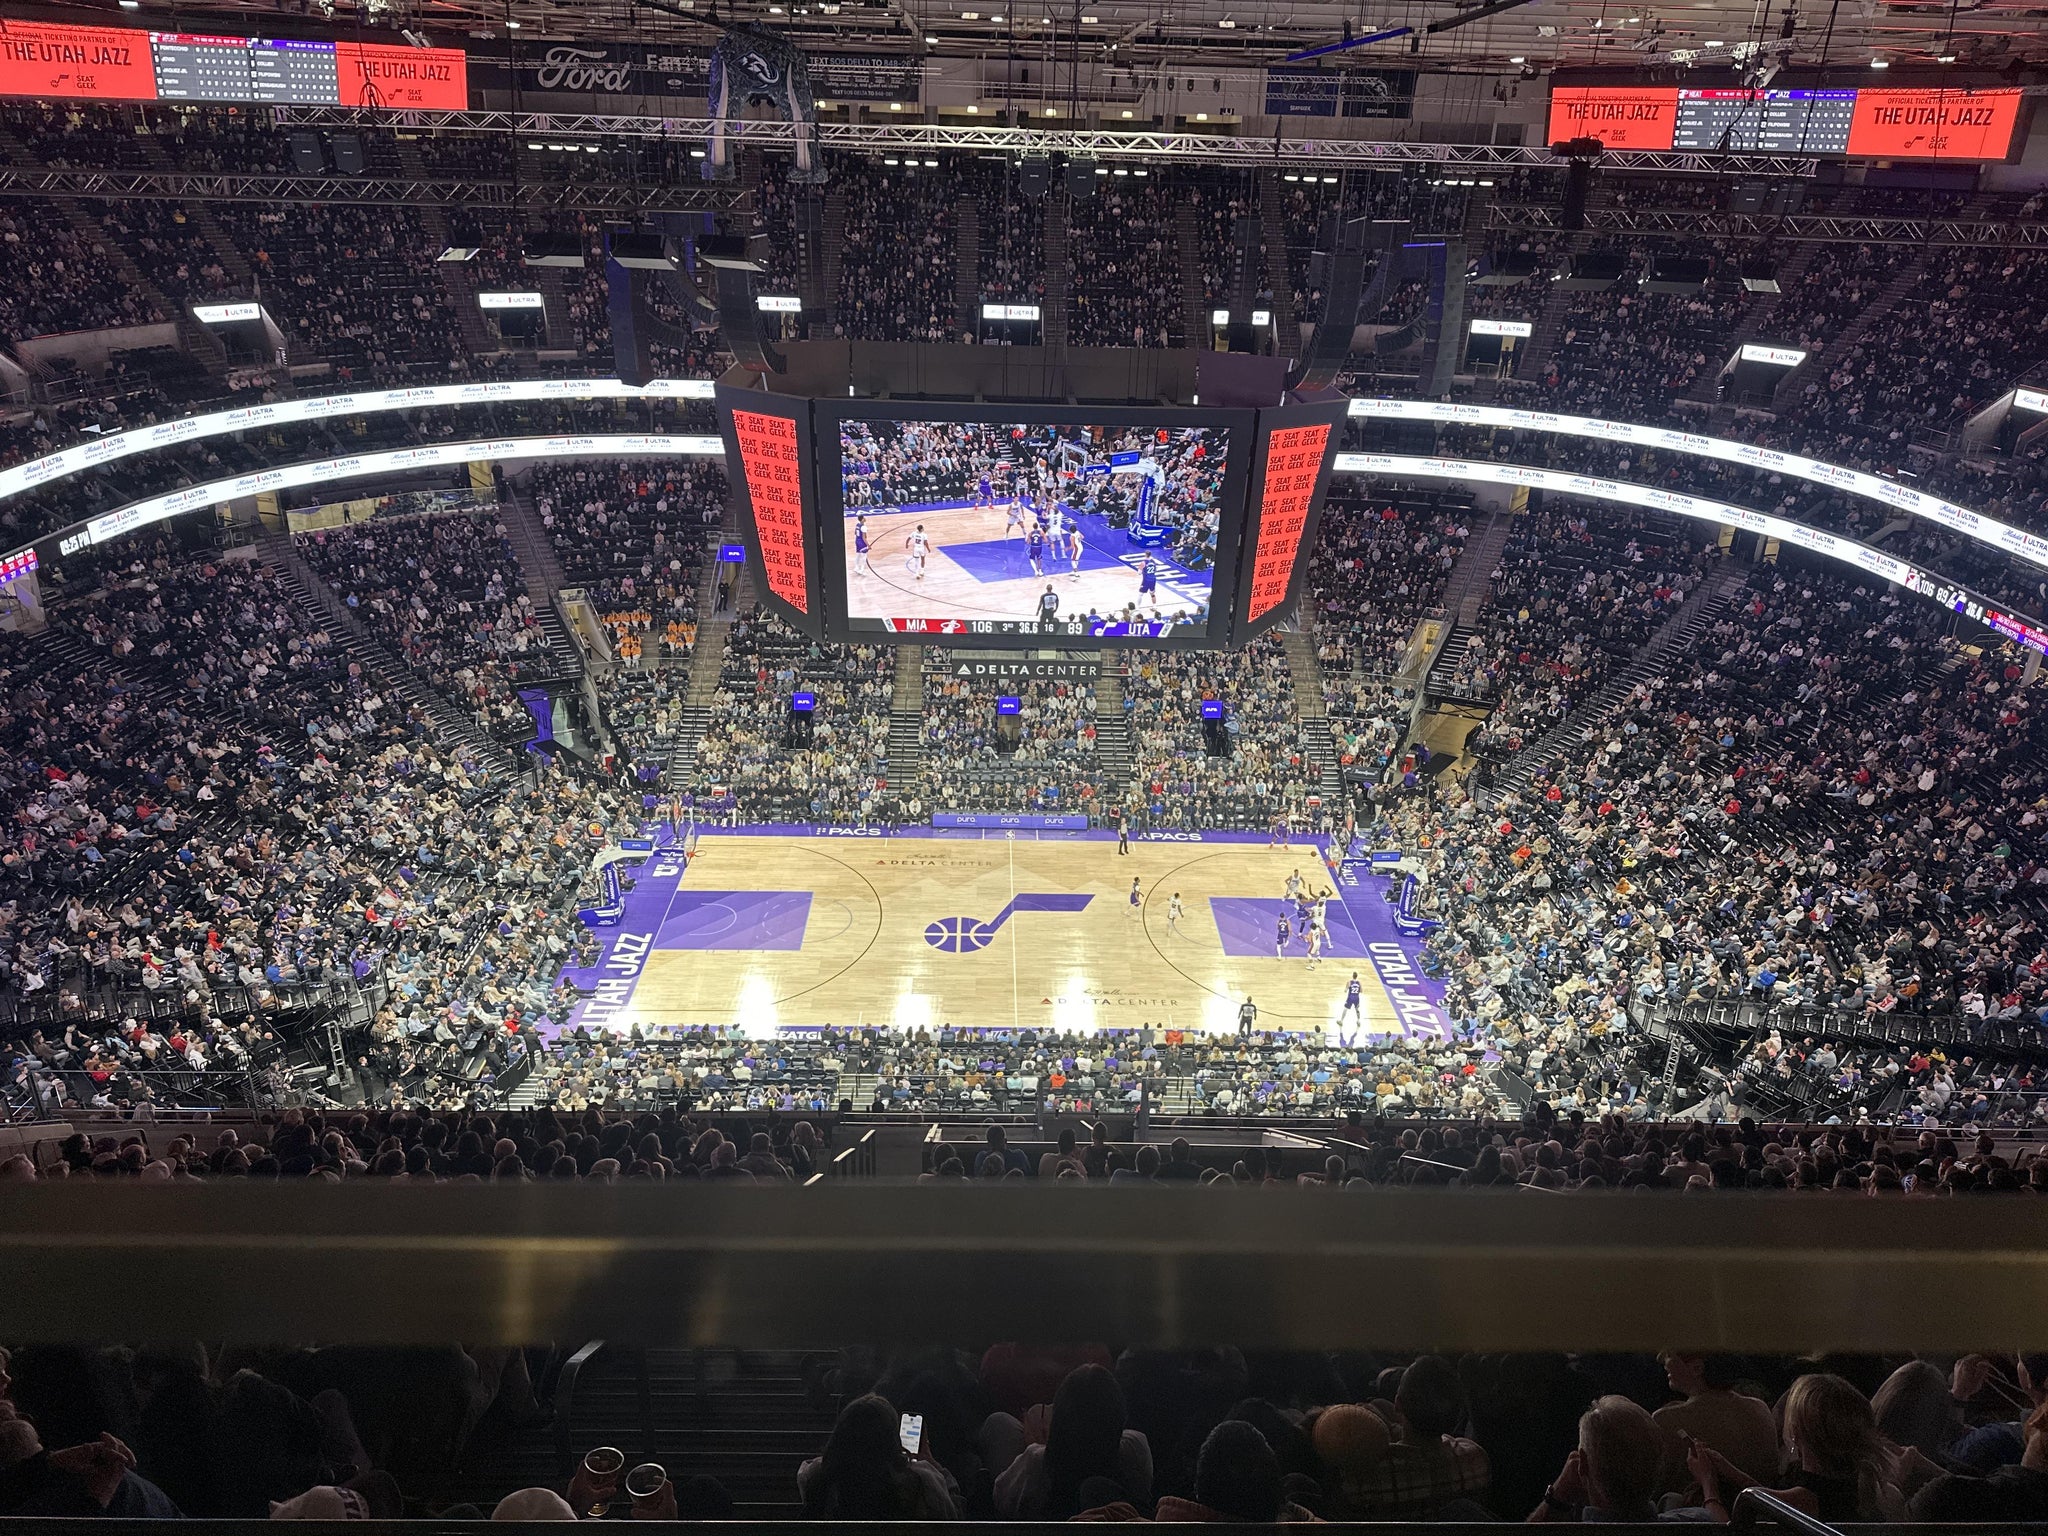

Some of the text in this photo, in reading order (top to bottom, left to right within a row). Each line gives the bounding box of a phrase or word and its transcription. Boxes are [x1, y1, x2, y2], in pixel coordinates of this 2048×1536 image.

[45, 33, 77, 41] TICKETING
[79, 35, 106, 43] PARTNER
[1, 42, 132, 66] THE UTAH JAZZ
[830, 57, 846, 65] SOS
[847, 58, 870, 66] DELTA
[355, 61, 450, 81] THE UTAH JAZZ
[538, 47, 630, 91] Ford
[1567, 104, 1659, 120] THE UTAH JAZZ
[1874, 107, 1994, 125] THE UTAH JAZZ
[1775, 353, 1798, 362] ULTRA
[252, 408, 273, 416] ULTRA
[177, 421, 196, 429] ULTRA
[749, 416, 785, 429] SEAT SEAT
[749, 425, 786, 438] GEEK GEEK
[1284, 429, 1320, 440] SEAT SEAT
[106, 437, 125, 448] ULTRA
[741, 437, 757, 447] SEAT
[762, 441, 776, 450] SEAT
[1282, 437, 1319, 448] GEEK GEEK
[741, 445, 779, 458] GEEK GEEK
[1764, 453, 1784, 461] ULTRA
[46, 456, 63, 466] ULTRA
[754, 462, 790, 474] SEAT SEAT
[261, 472, 282, 481] ULTRA
[754, 470, 792, 483] GEEK GEEK
[1276, 474, 1311, 485] SEAT SEAT
[1274, 481, 1310, 493] GEEK GEEK
[188, 489, 207, 498] ULTRA
[1672, 496, 1692, 505] ULTRA
[121, 509, 137, 519] ULTRA
[759, 506, 795, 518] SEAT SEAT
[1961, 511, 1979, 524] ULTRA
[759, 513, 797, 527] GEEK GEEK
[1268, 517, 1303, 529] SEAT SEAT
[1266, 525, 1302, 536] GEEK GEEK
[2028, 538, 2047, 551] ULTRA
[1880, 556, 1898, 569] ULTRA
[777, 571, 792, 580] SEAT
[777, 578, 794, 588] GEEK
[1267, 581, 1282, 589] SEAT
[1265, 588, 1281, 597] GEEK
[1921, 580, 1949, 603] 106 89
[1966, 601, 1983, 620] 36.4
[906, 619, 927, 630] MIA
[972, 621, 992, 632] 106
[1019, 622, 1038, 633] 36.6
[1044, 624, 1054, 632] 16
[1068, 623, 1082, 634] 89
[1128, 624, 1150, 634] UTA
[976, 665, 1096, 675] DELTA CENTER
[578, 933, 652, 1027] UTAH JAZZ
[1369, 943, 1445, 1035] UTAH JAZZ
